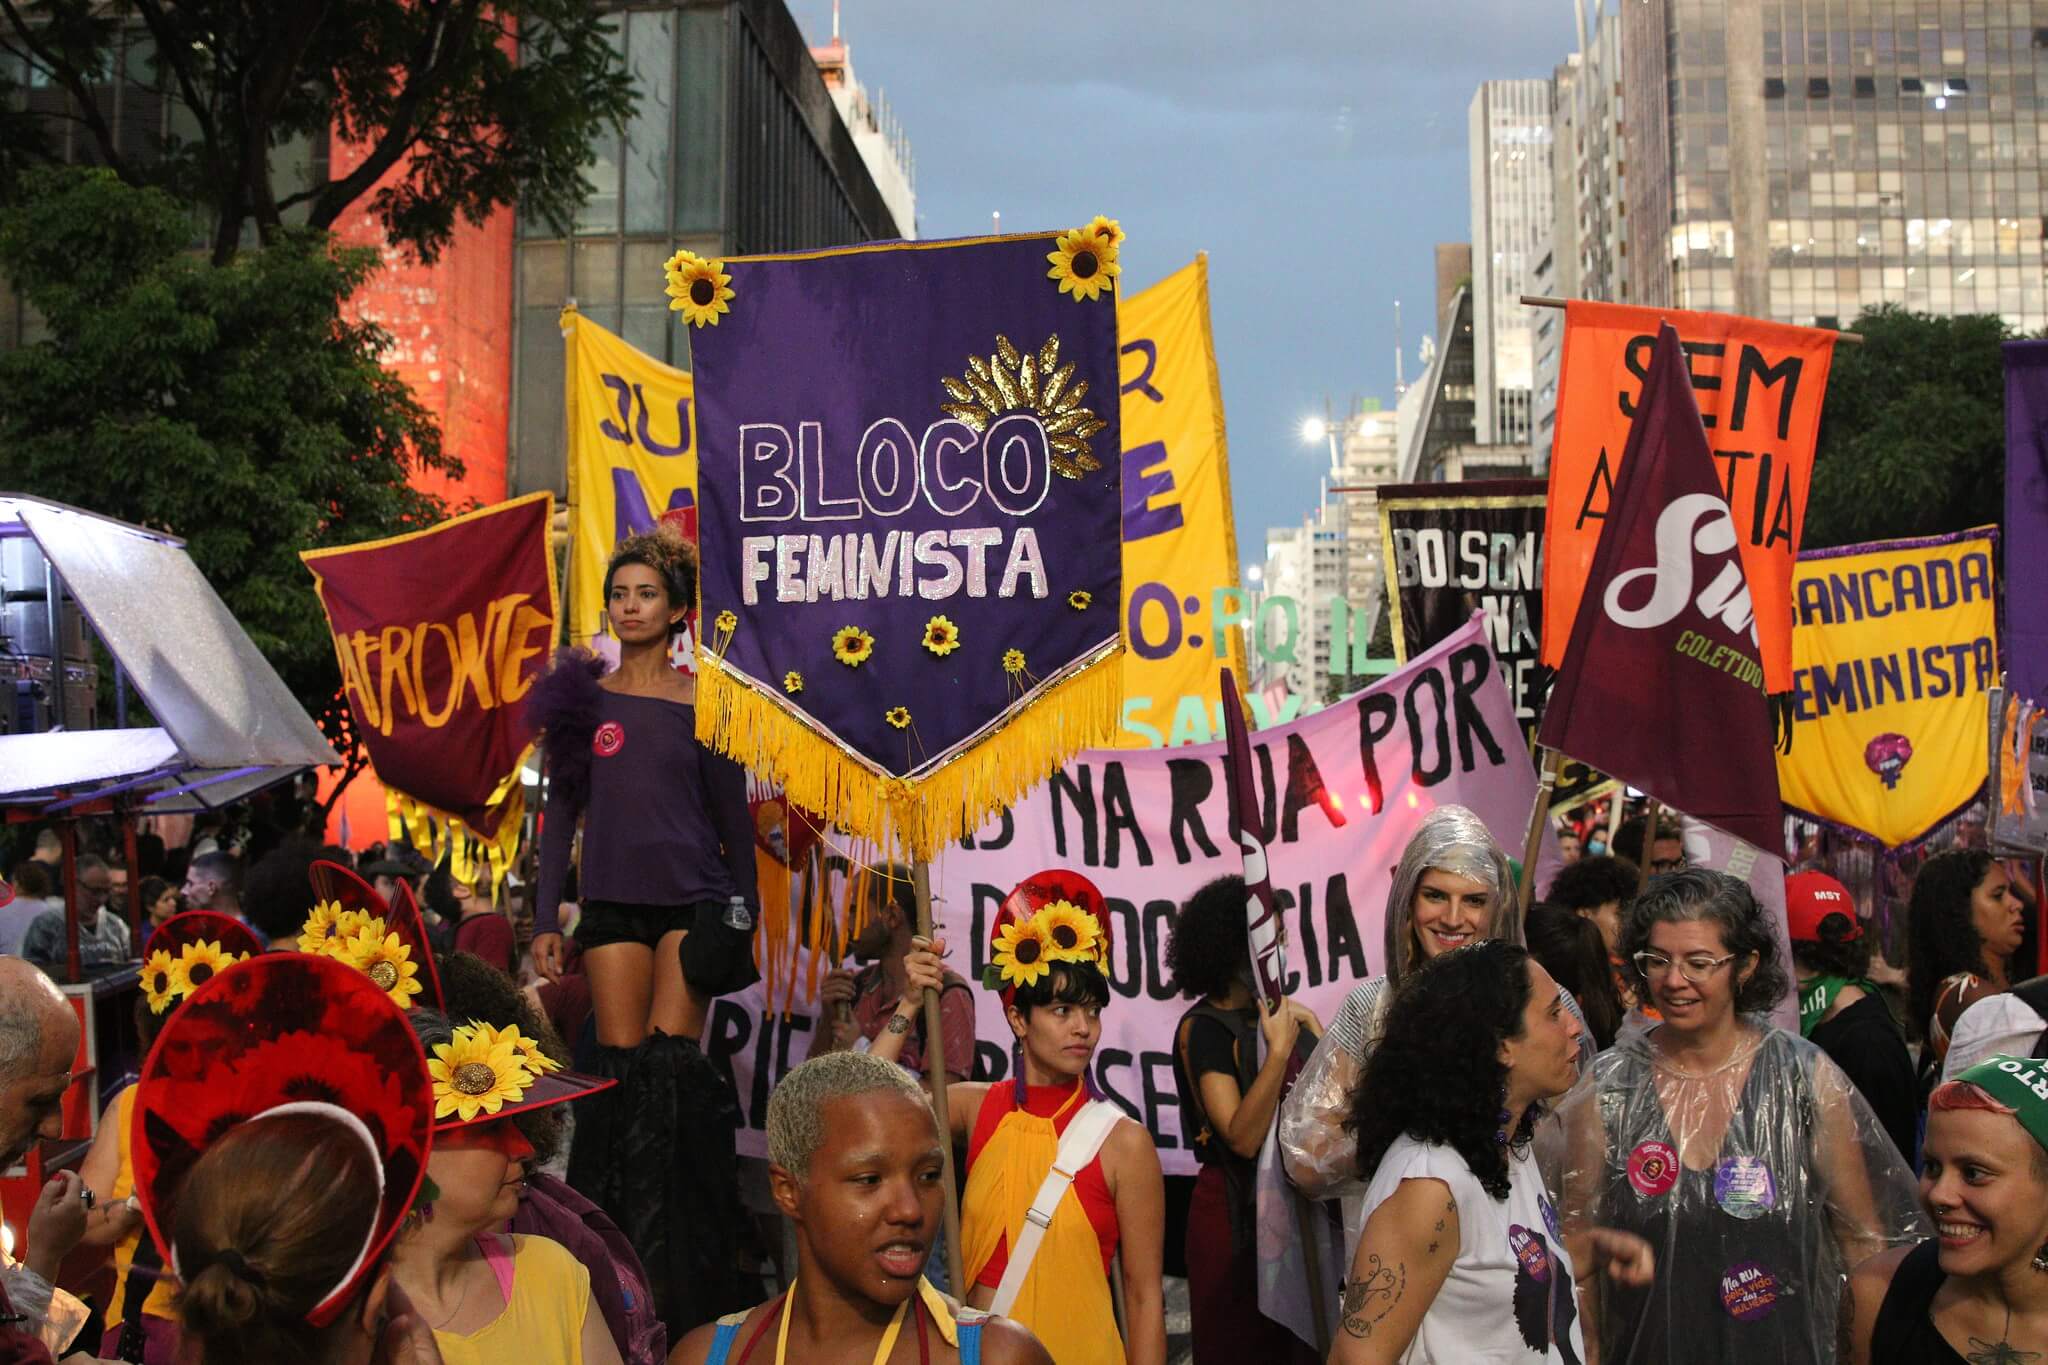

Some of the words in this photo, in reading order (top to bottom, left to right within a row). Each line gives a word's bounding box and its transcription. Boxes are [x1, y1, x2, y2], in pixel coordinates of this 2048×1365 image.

[740, 414, 1050, 521] BLOCO
[742, 527, 1049, 605] FEMINISTA
[1393, 528, 1543, 591] BOLSON
[1791, 552, 1991, 627] ANCADA
[1675, 630, 1763, 689] COLETIVO
[1793, 636, 1994, 723] EMINISTA
[1050, 759, 1154, 869] NA
[1165, 731, 1347, 865] RUA
[1358, 643, 1506, 816] POR
[1814, 890, 1842, 902] MST
[1738, 1267, 1762, 1283] RUA
